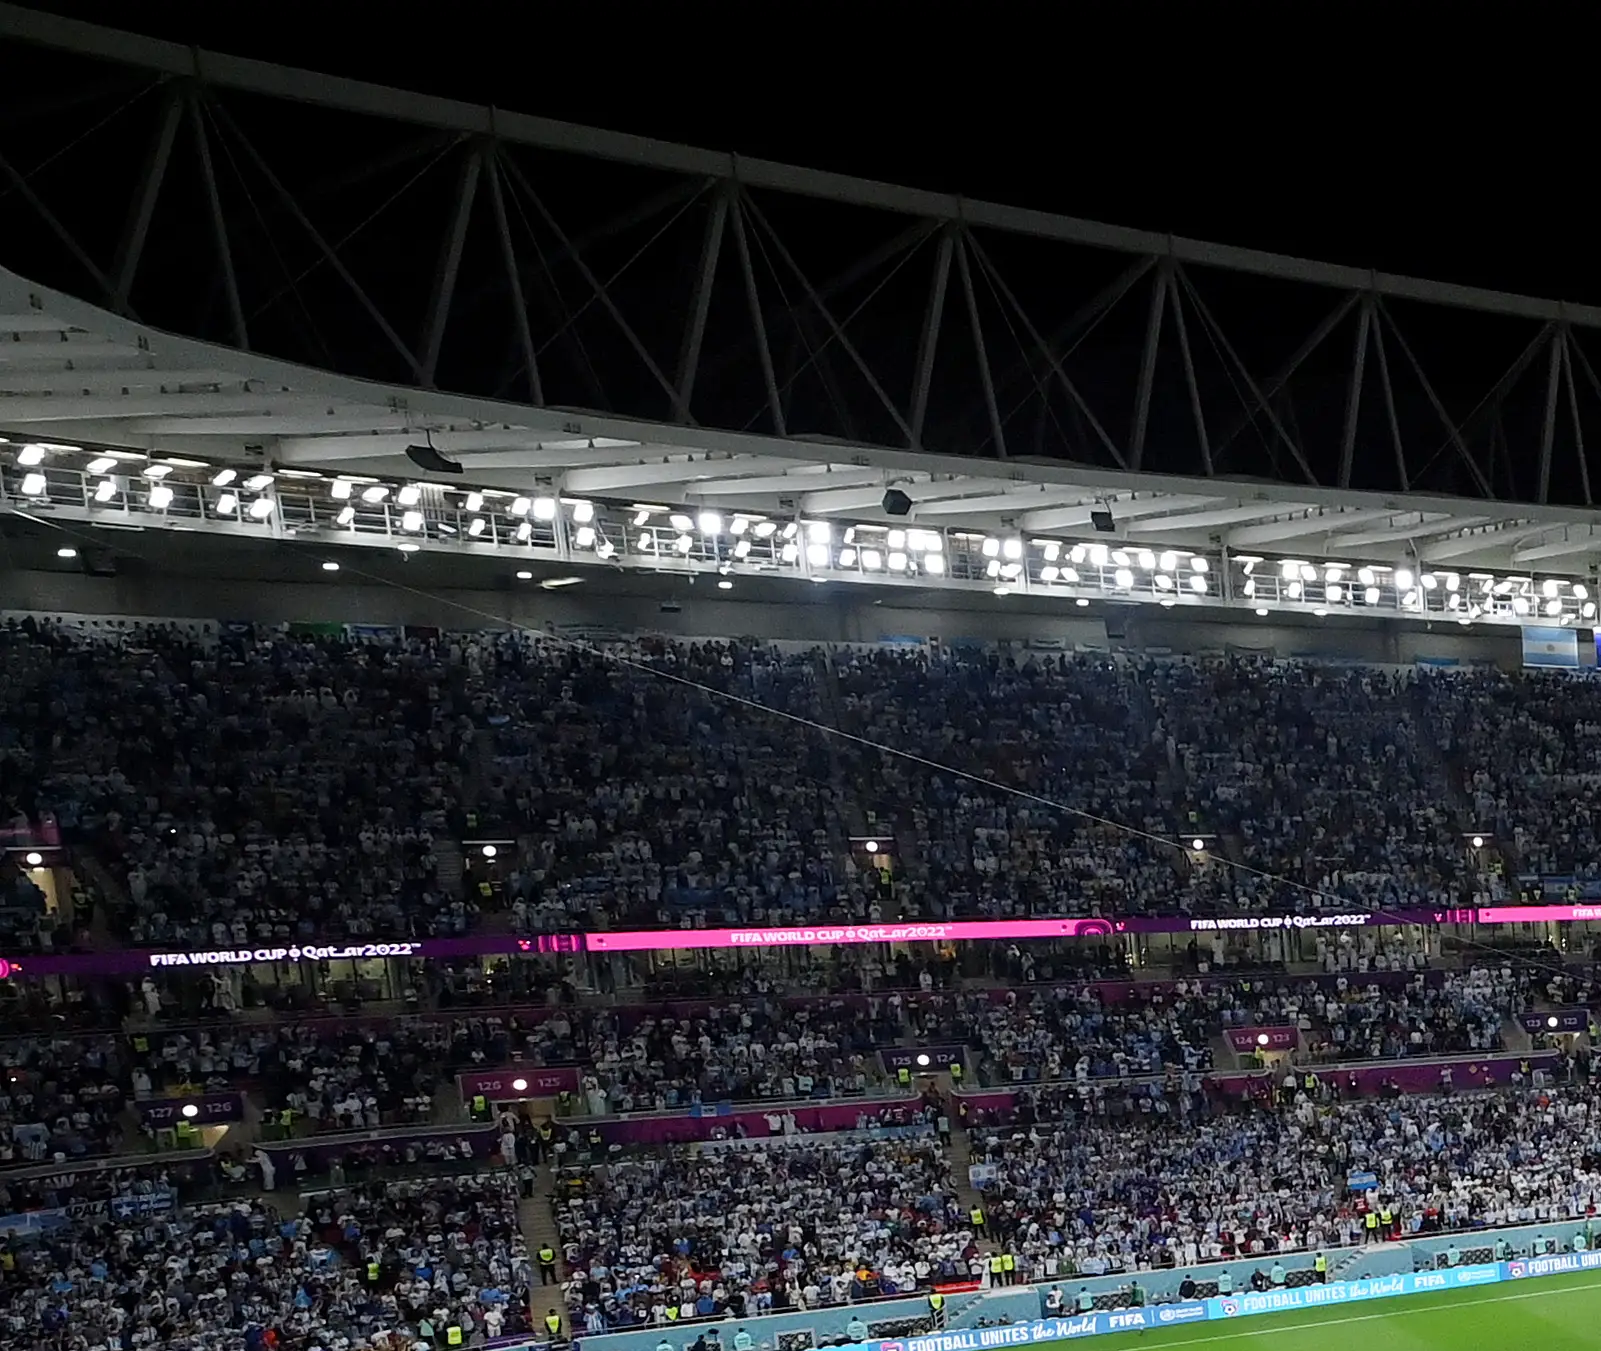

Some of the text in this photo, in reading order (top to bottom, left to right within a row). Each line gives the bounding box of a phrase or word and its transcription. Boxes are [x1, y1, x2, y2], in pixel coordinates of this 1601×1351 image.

[1190, 919, 1217, 930] FIFA
[1217, 918, 1259, 930] WORLD
[1260, 916, 1284, 928] CUP
[731, 932, 762, 943] FIFA
[762, 930, 815, 942] WORLD
[817, 929, 844, 941] CUP
[150, 953, 189, 967] FIFA
[189, 951, 252, 966] WORLD
[254, 949, 288, 962] CUP
[477, 1077, 561, 1092] 126 125
[149, 1101, 232, 1119] 127 126
[1528, 1253, 1580, 1274] FOOTBALL
[1244, 1274, 1446, 1311] FOOTBALL UNITES the World FIFA
[980, 1326, 1029, 1346] UNITES
[1031, 1322, 1056, 1341] the
[1056, 1316, 1098, 1337] World
[1109, 1312, 1146, 1329] FIFA
